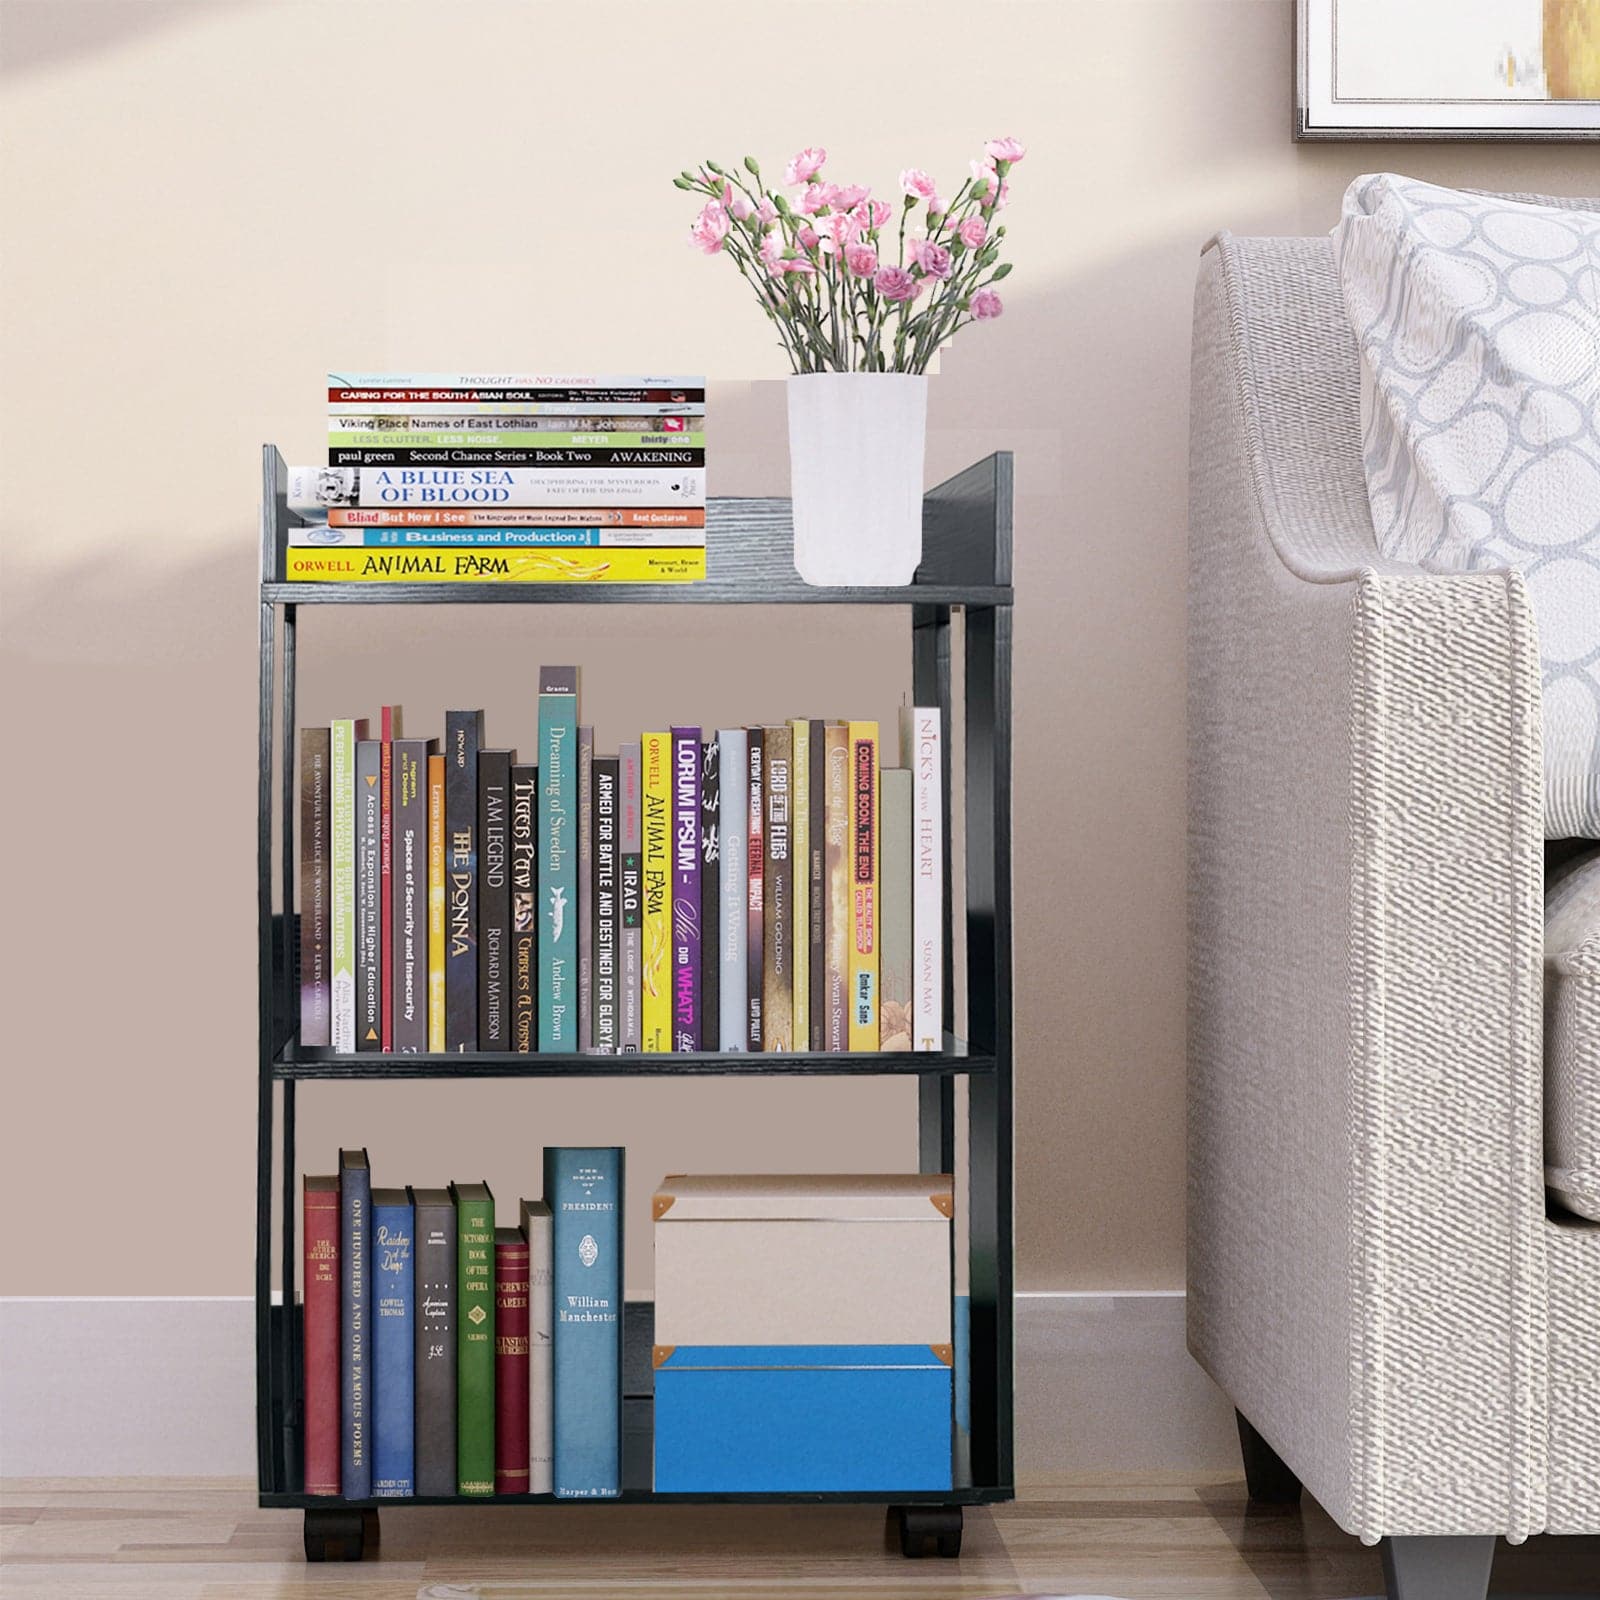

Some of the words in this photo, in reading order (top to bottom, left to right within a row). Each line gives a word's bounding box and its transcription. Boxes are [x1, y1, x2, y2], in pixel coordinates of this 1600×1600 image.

[340, 391, 380, 400] CARING
[383, 391, 406, 400] FOR
[408, 391, 430, 400] THE
[432, 391, 468, 400] SOUTH
[470, 391, 503, 400] ASIAN
[459, 376, 512, 385] THOUGHT
[534, 376, 553, 385] NO
[339, 419, 374, 429] Viking
[377, 419, 408, 429] Place
[412, 419, 450, 429] Names
[453, 419, 464, 429] of
[467, 419, 493, 429] East
[496, 419, 538, 429] Lothian
[353, 435, 379, 444] LESS
[437, 435, 463, 444] LESS
[572, 435, 608, 444] MEYER
[338, 451, 361, 462] paul
[364, 451, 395, 462] green
[410, 450, 449, 461] Second
[451, 450, 492, 461] Chance
[494, 450, 527, 461] Series
[536, 450, 564, 461] Book
[566, 450, 591, 461] Two
[610, 452, 692, 462] AWAKENING
[376, 471, 393, 484] A
[402, 471, 465, 484] BLUE
[471, 471, 514, 484] SEA
[381, 488, 414, 501] OF
[422, 488, 509, 501] BLOOD
[347, 512, 379, 523] Blind
[382, 512, 404, 523] But
[435, 512, 440, 523] I
[443, 512, 465, 523] See
[405, 532, 473, 542] Business
[477, 532, 501, 542] and
[505, 532, 576, 542] Production
[293, 561, 355, 571] ORWELL
[361, 555, 446, 575] ANIMAL
[455, 555, 510, 575] FARM
[336, 726, 344, 803] PERFORMING
[545, 727, 566, 797] Dreaming
[649, 738, 660, 788] ORWELL
[750, 747, 762, 781] EVERYDAY
[796, 737, 808, 771] Dance
[920, 719, 934, 781] NICK'S
[678, 739, 696, 806] LORUM
[770, 760, 787, 791] LORD
[858, 746, 869, 791] COMING
[550, 800, 566, 814] of
[599, 774, 612, 814] ARMED
[772, 795, 785, 806] OF
[796, 777, 808, 804] with
[367, 795, 376, 834] Access
[487, 796, 504, 821] AM
[750, 782, 762, 834] CONVERSATIONS
[858, 793, 869, 828] SOON.
[336, 807, 344, 864] PHYSICAL
[367, 838, 376, 846] &
[599, 818, 612, 840] FOR
[645, 793, 665, 863] ANIMAL
[678, 811, 696, 870] IPSUM
[796, 808, 808, 843] Them
[858, 831, 869, 853] THE
[402, 829, 414, 870] Spaces
[453, 825, 472, 868] THE
[487, 827, 504, 887] LEGEND
[550, 817, 566, 871] Sweden
[920, 818, 932, 879] HEART
[314, 866, 321, 875] IN
[365, 850, 376, 907] Expansion
[404, 873, 414, 885] of
[513, 842, 535, 888] PAW
[599, 844, 612, 886] BATTLE
[725, 835, 741, 892] Getting
[858, 856, 869, 879] END
[599, 892, 612, 916] AND
[623, 870, 637, 910] IRAQ
[646, 870, 665, 915] FARM
[728, 896, 741, 907] It
[750, 878, 762, 911] IMPACT
[774, 875, 782, 919] WILLIAM
[336, 870, 344, 958] EXAMINATIONS
[401, 888, 414, 935] Security
[451, 872, 472, 957] DONNA
[673, 898, 700, 942] She
[365, 926, 376, 962] Higher
[404, 938, 414, 959] and
[599, 919, 612, 974] DESTINED
[627, 932, 635, 946] THE
[725, 908, 741, 962] Wrong
[774, 922, 782, 975] GOLDING
[487, 928, 501, 978] RICHARD
[627, 950, 635, 972] LOGIC
[678, 946, 688, 964] DID
[923, 940, 933, 982] SUSAN
[367, 966, 376, 1022] Education
[401, 962, 414, 1021] Insecurity
[552, 957, 565, 999] Andrew
[599, 978, 612, 1000] FOR
[627, 976, 635, 985] OF
[677, 966, 693, 1024] WHAT?
[832, 975, 842, 1005] Swan
[858, 973, 870, 1000] Omkar
[487, 981, 501, 1040] MATHESON
[627, 990, 635, 1037] WITHDRAWAL
[858, 1005, 870, 1024] Sane
[923, 987, 933, 1016] MAY
[552, 1004, 565, 1040] Brown
[599, 1004, 612, 1048] GLORY!
[832, 1008, 842, 1051] Stewart
[352, 1199, 362, 1227] ONE
[471, 1218, 485, 1227] THE
[352, 1232, 362, 1298] HUNDRED
[465, 1265, 474, 1275] OF
[475, 1265, 488, 1275] THE
[468, 1250, 487, 1259] BOOK
[466, 1282, 488, 1290] OPERA
[567, 1296, 608, 1307] William
[352, 1303, 362, 1330] AND
[560, 1310, 616, 1322] Manchester
[353, 1334, 363, 1361] ONE
[353, 1366, 363, 1418] FAMOUS
[353, 1423, 363, 1466] POEMS
